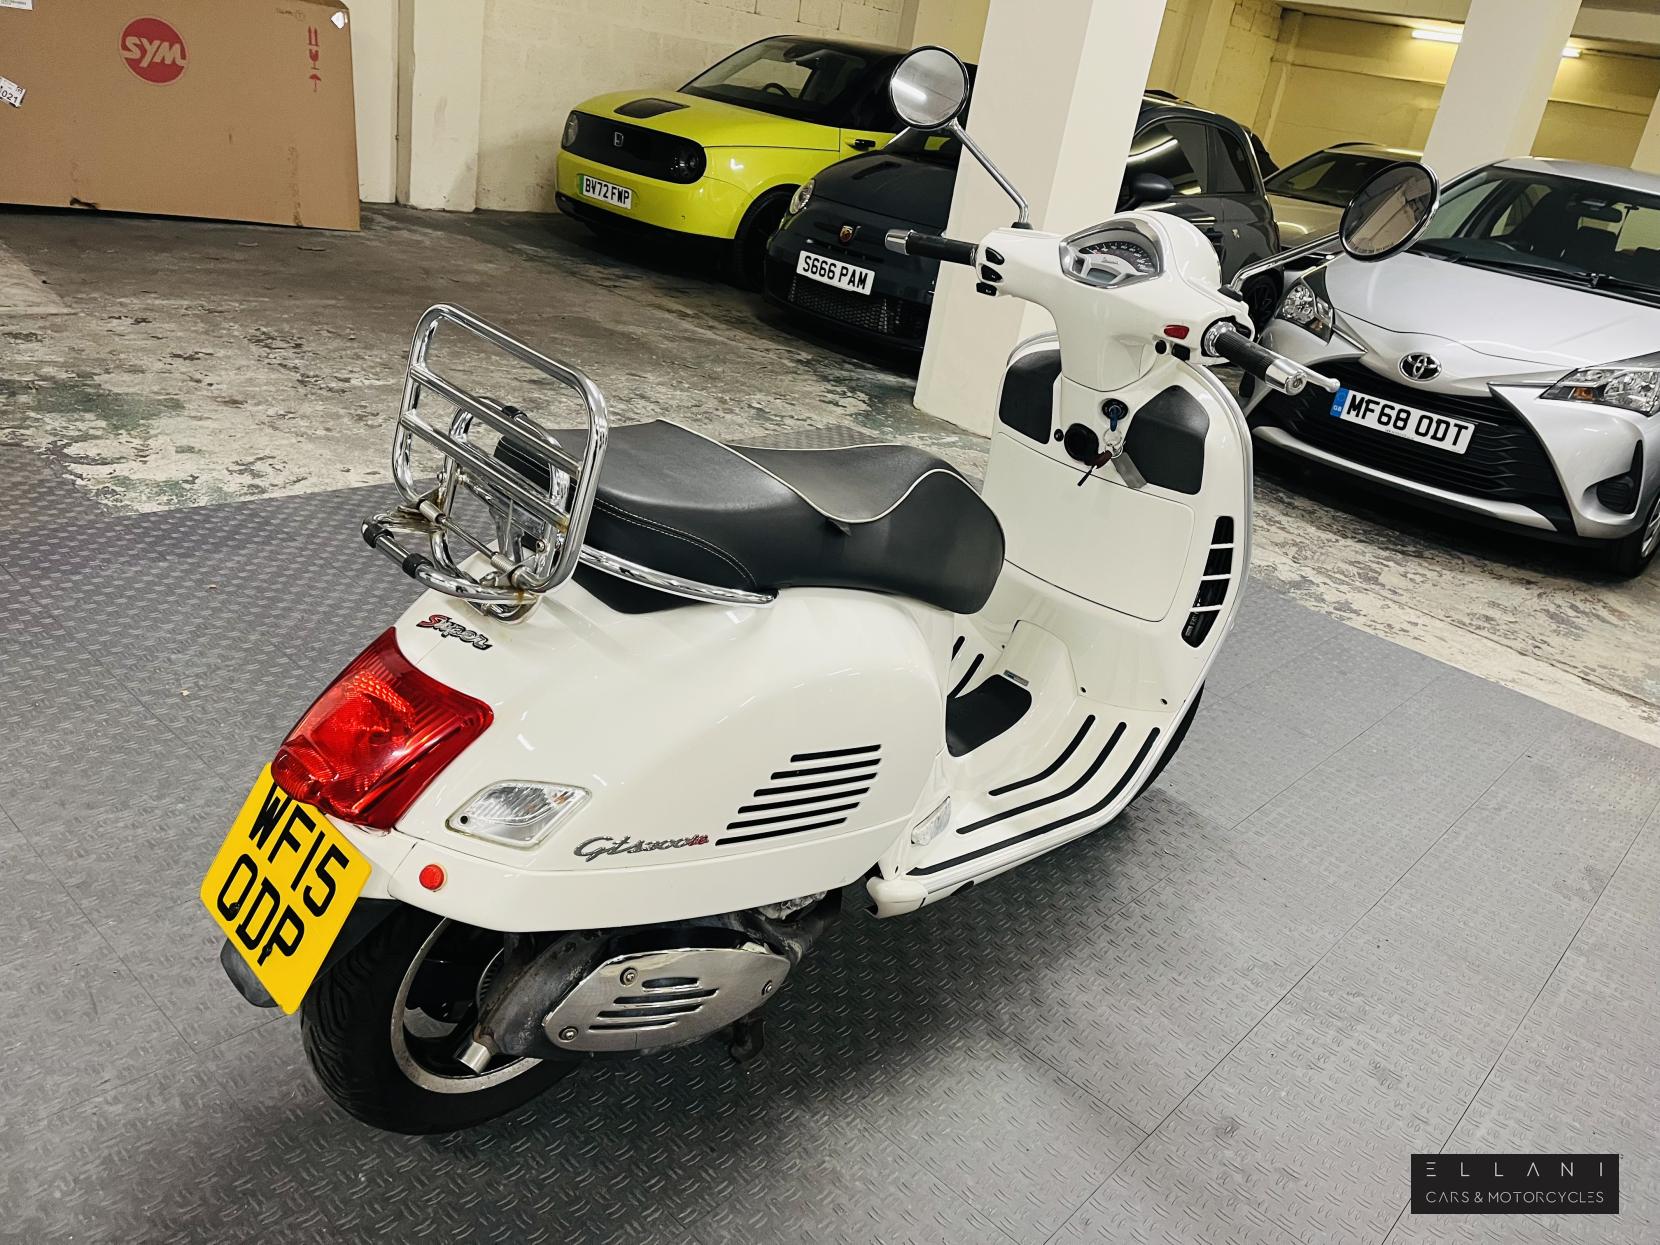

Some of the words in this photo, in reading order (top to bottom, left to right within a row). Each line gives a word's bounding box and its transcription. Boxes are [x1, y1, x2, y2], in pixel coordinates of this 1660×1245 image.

[121, 36, 187, 68] SYM
[0, 86, 18, 103] 021
[585, 178, 609, 199] BV72
[610, 186, 630, 205] FWP
[803, 255, 837, 280] S666
[838, 266, 868, 290] PAM
[1346, 394, 1411, 431] MF68
[1415, 414, 1469, 446] ODT
[416, 614, 493, 650] Super
[249, 782, 350, 917] WF15
[217, 853, 305, 967] ODP
